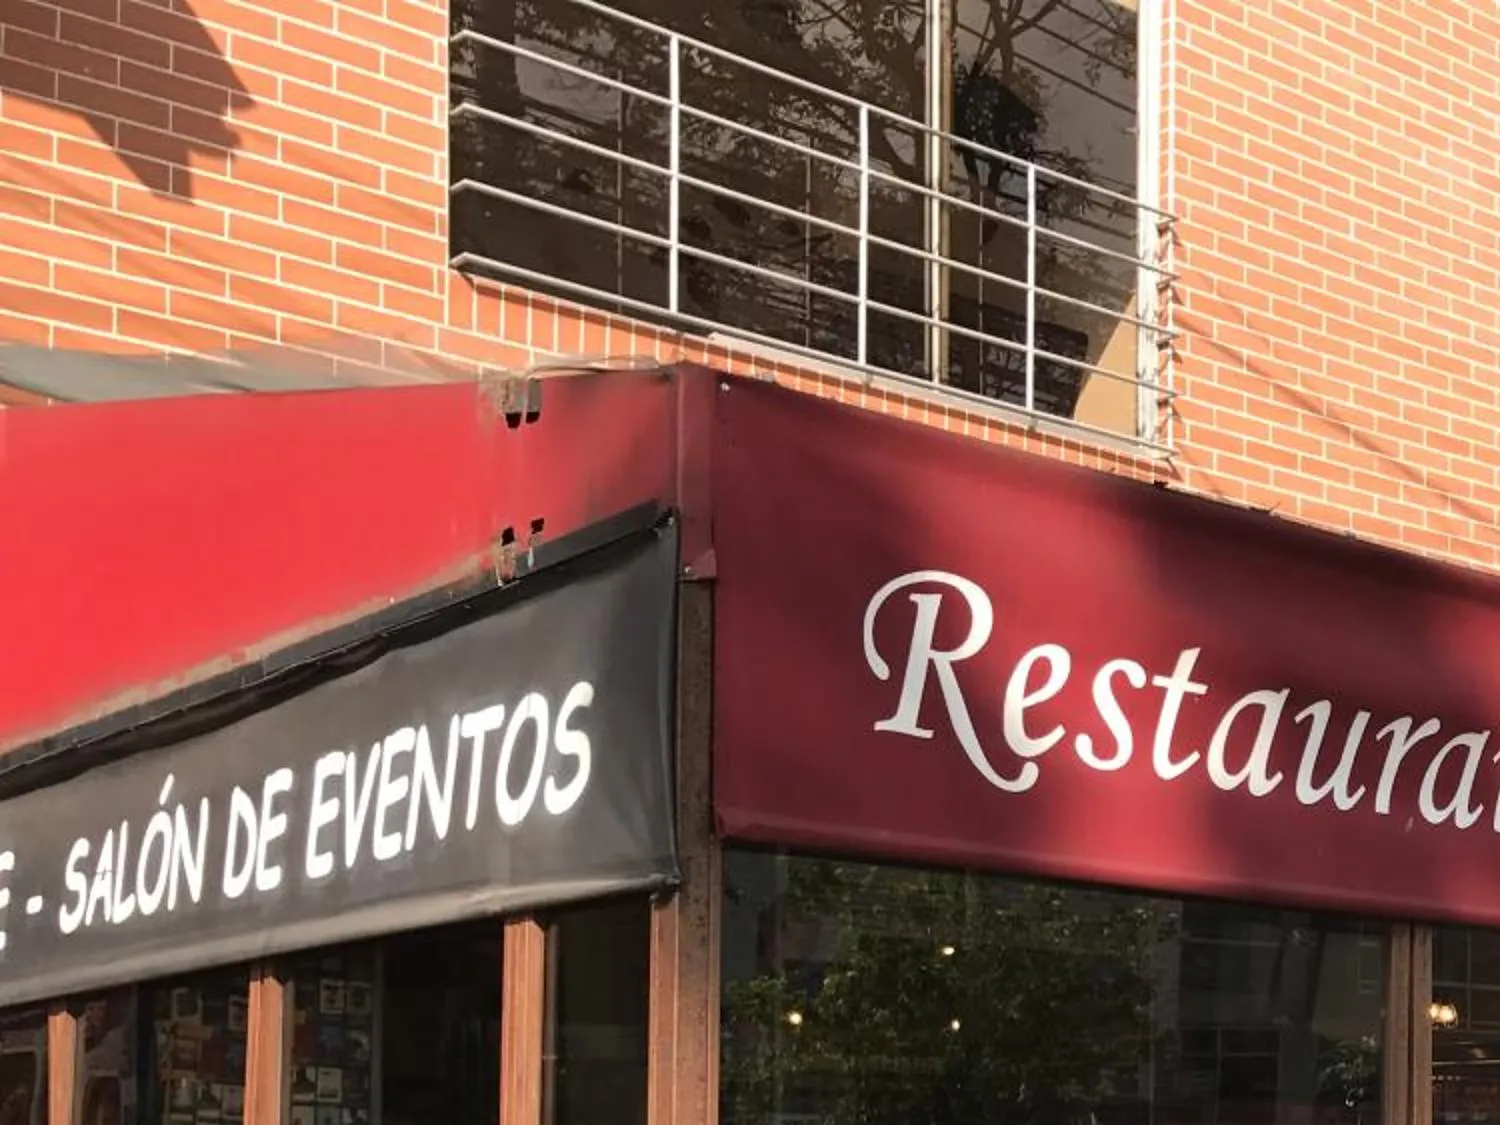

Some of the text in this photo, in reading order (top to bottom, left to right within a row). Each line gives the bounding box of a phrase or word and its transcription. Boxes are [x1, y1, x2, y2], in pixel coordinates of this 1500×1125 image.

[59, 774, 208, 934] SALÓN
[223, 768, 292, 898] DE
[305, 682, 595, 879] EVENTOS
